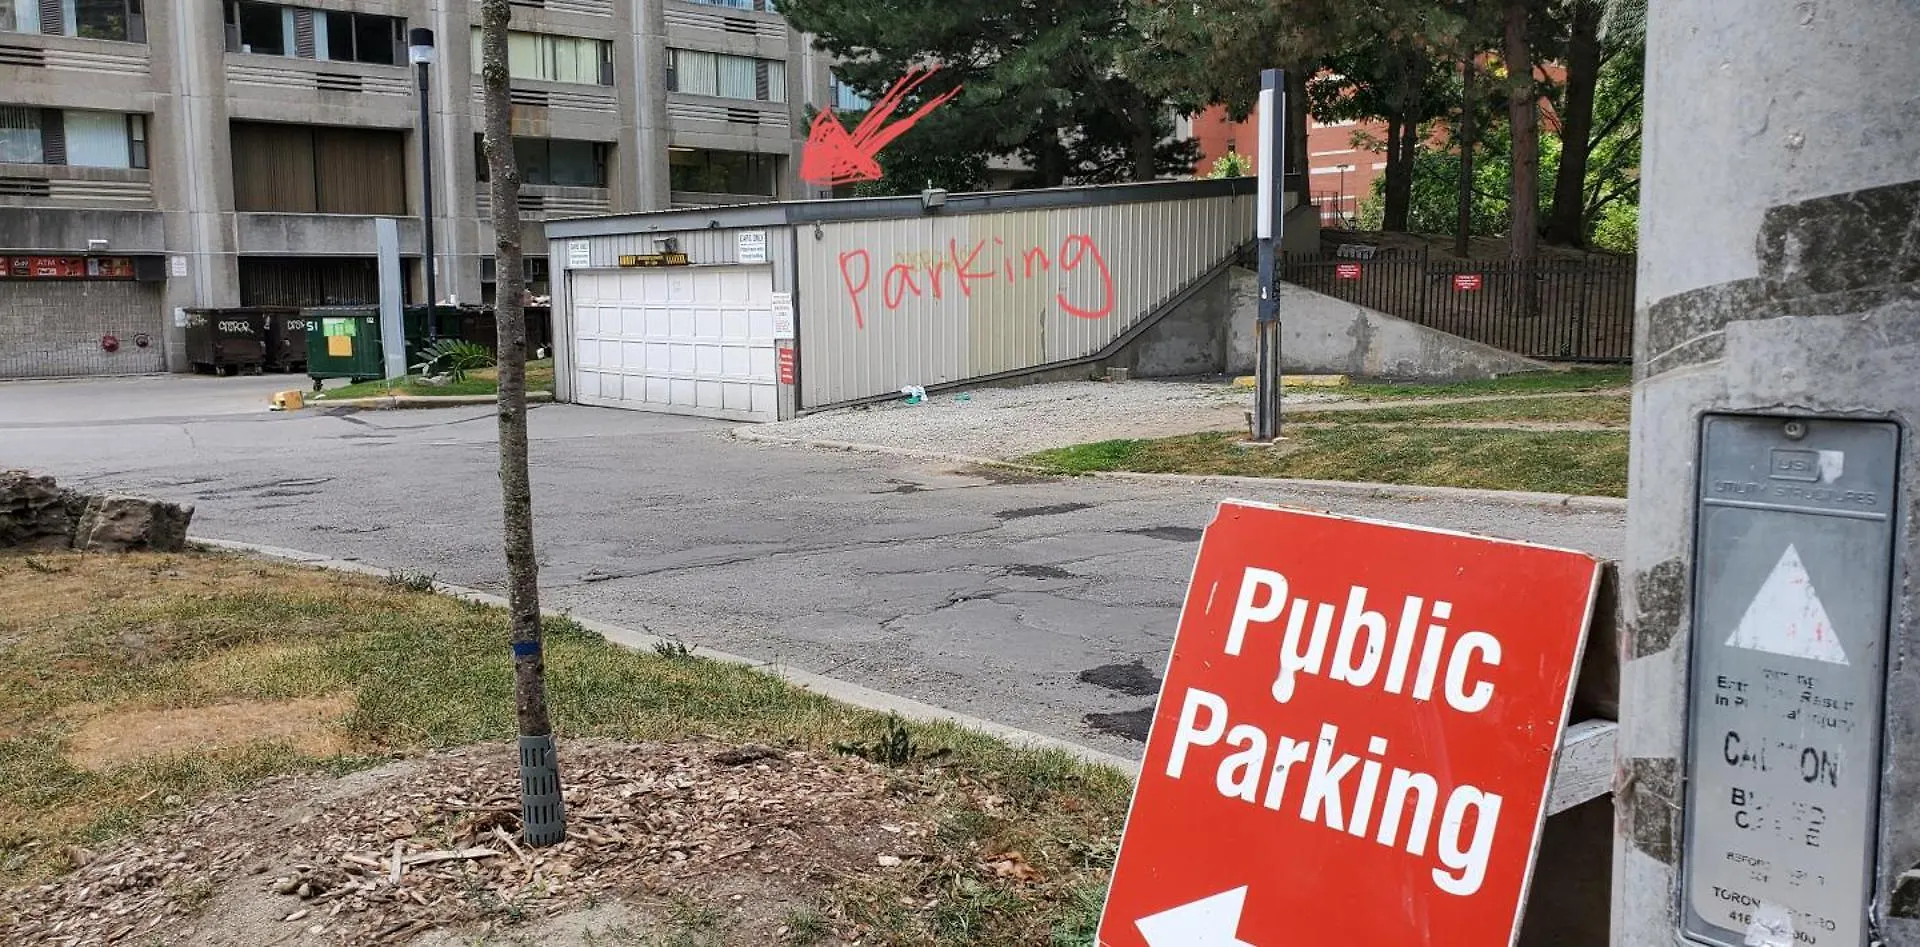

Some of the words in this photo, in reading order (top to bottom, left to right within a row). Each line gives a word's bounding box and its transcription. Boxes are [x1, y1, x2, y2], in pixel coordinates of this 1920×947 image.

[37, 258, 56, 266] ATM
[1715, 480, 1768, 495] UTILITY
[1223, 566, 1502, 714] Public
[1166, 687, 1503, 896] Parking
